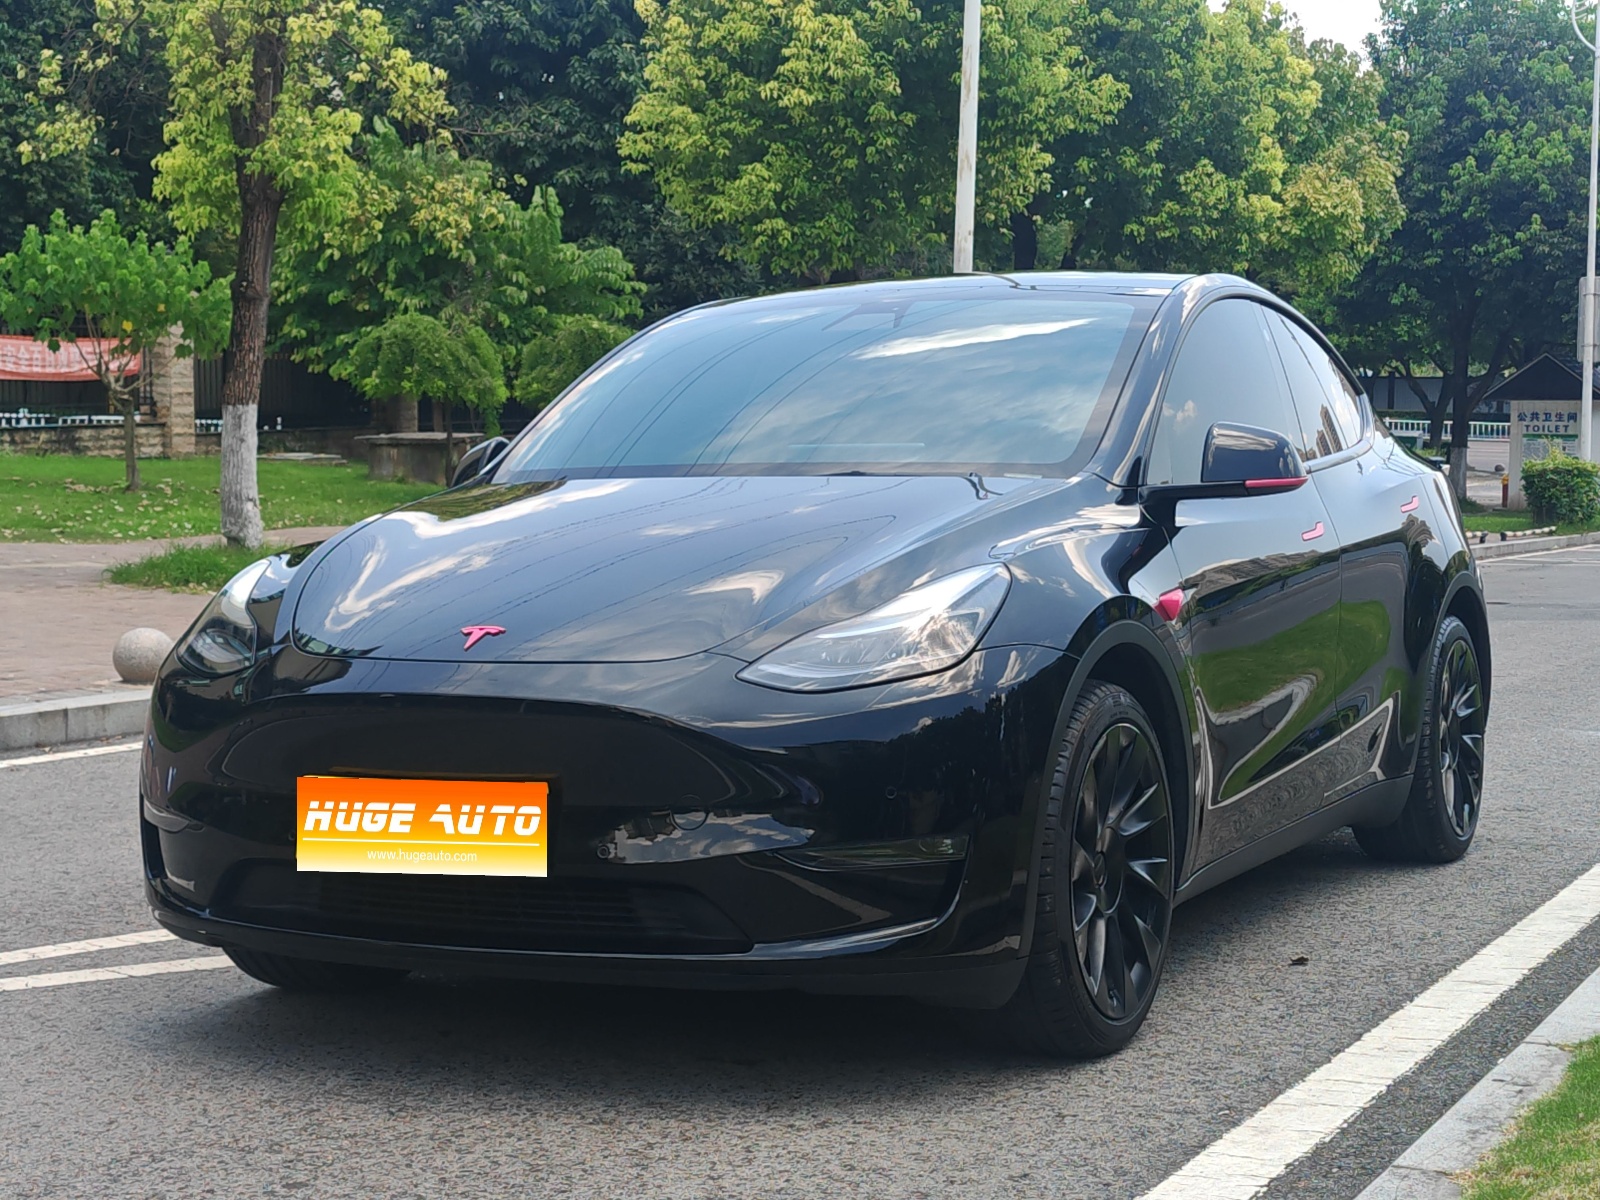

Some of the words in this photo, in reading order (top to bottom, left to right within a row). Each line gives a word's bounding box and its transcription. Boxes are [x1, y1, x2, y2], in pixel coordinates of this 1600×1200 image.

[1517, 411, 1577, 423] 公共卫生间
[1524, 424, 1570, 433] TOILET
